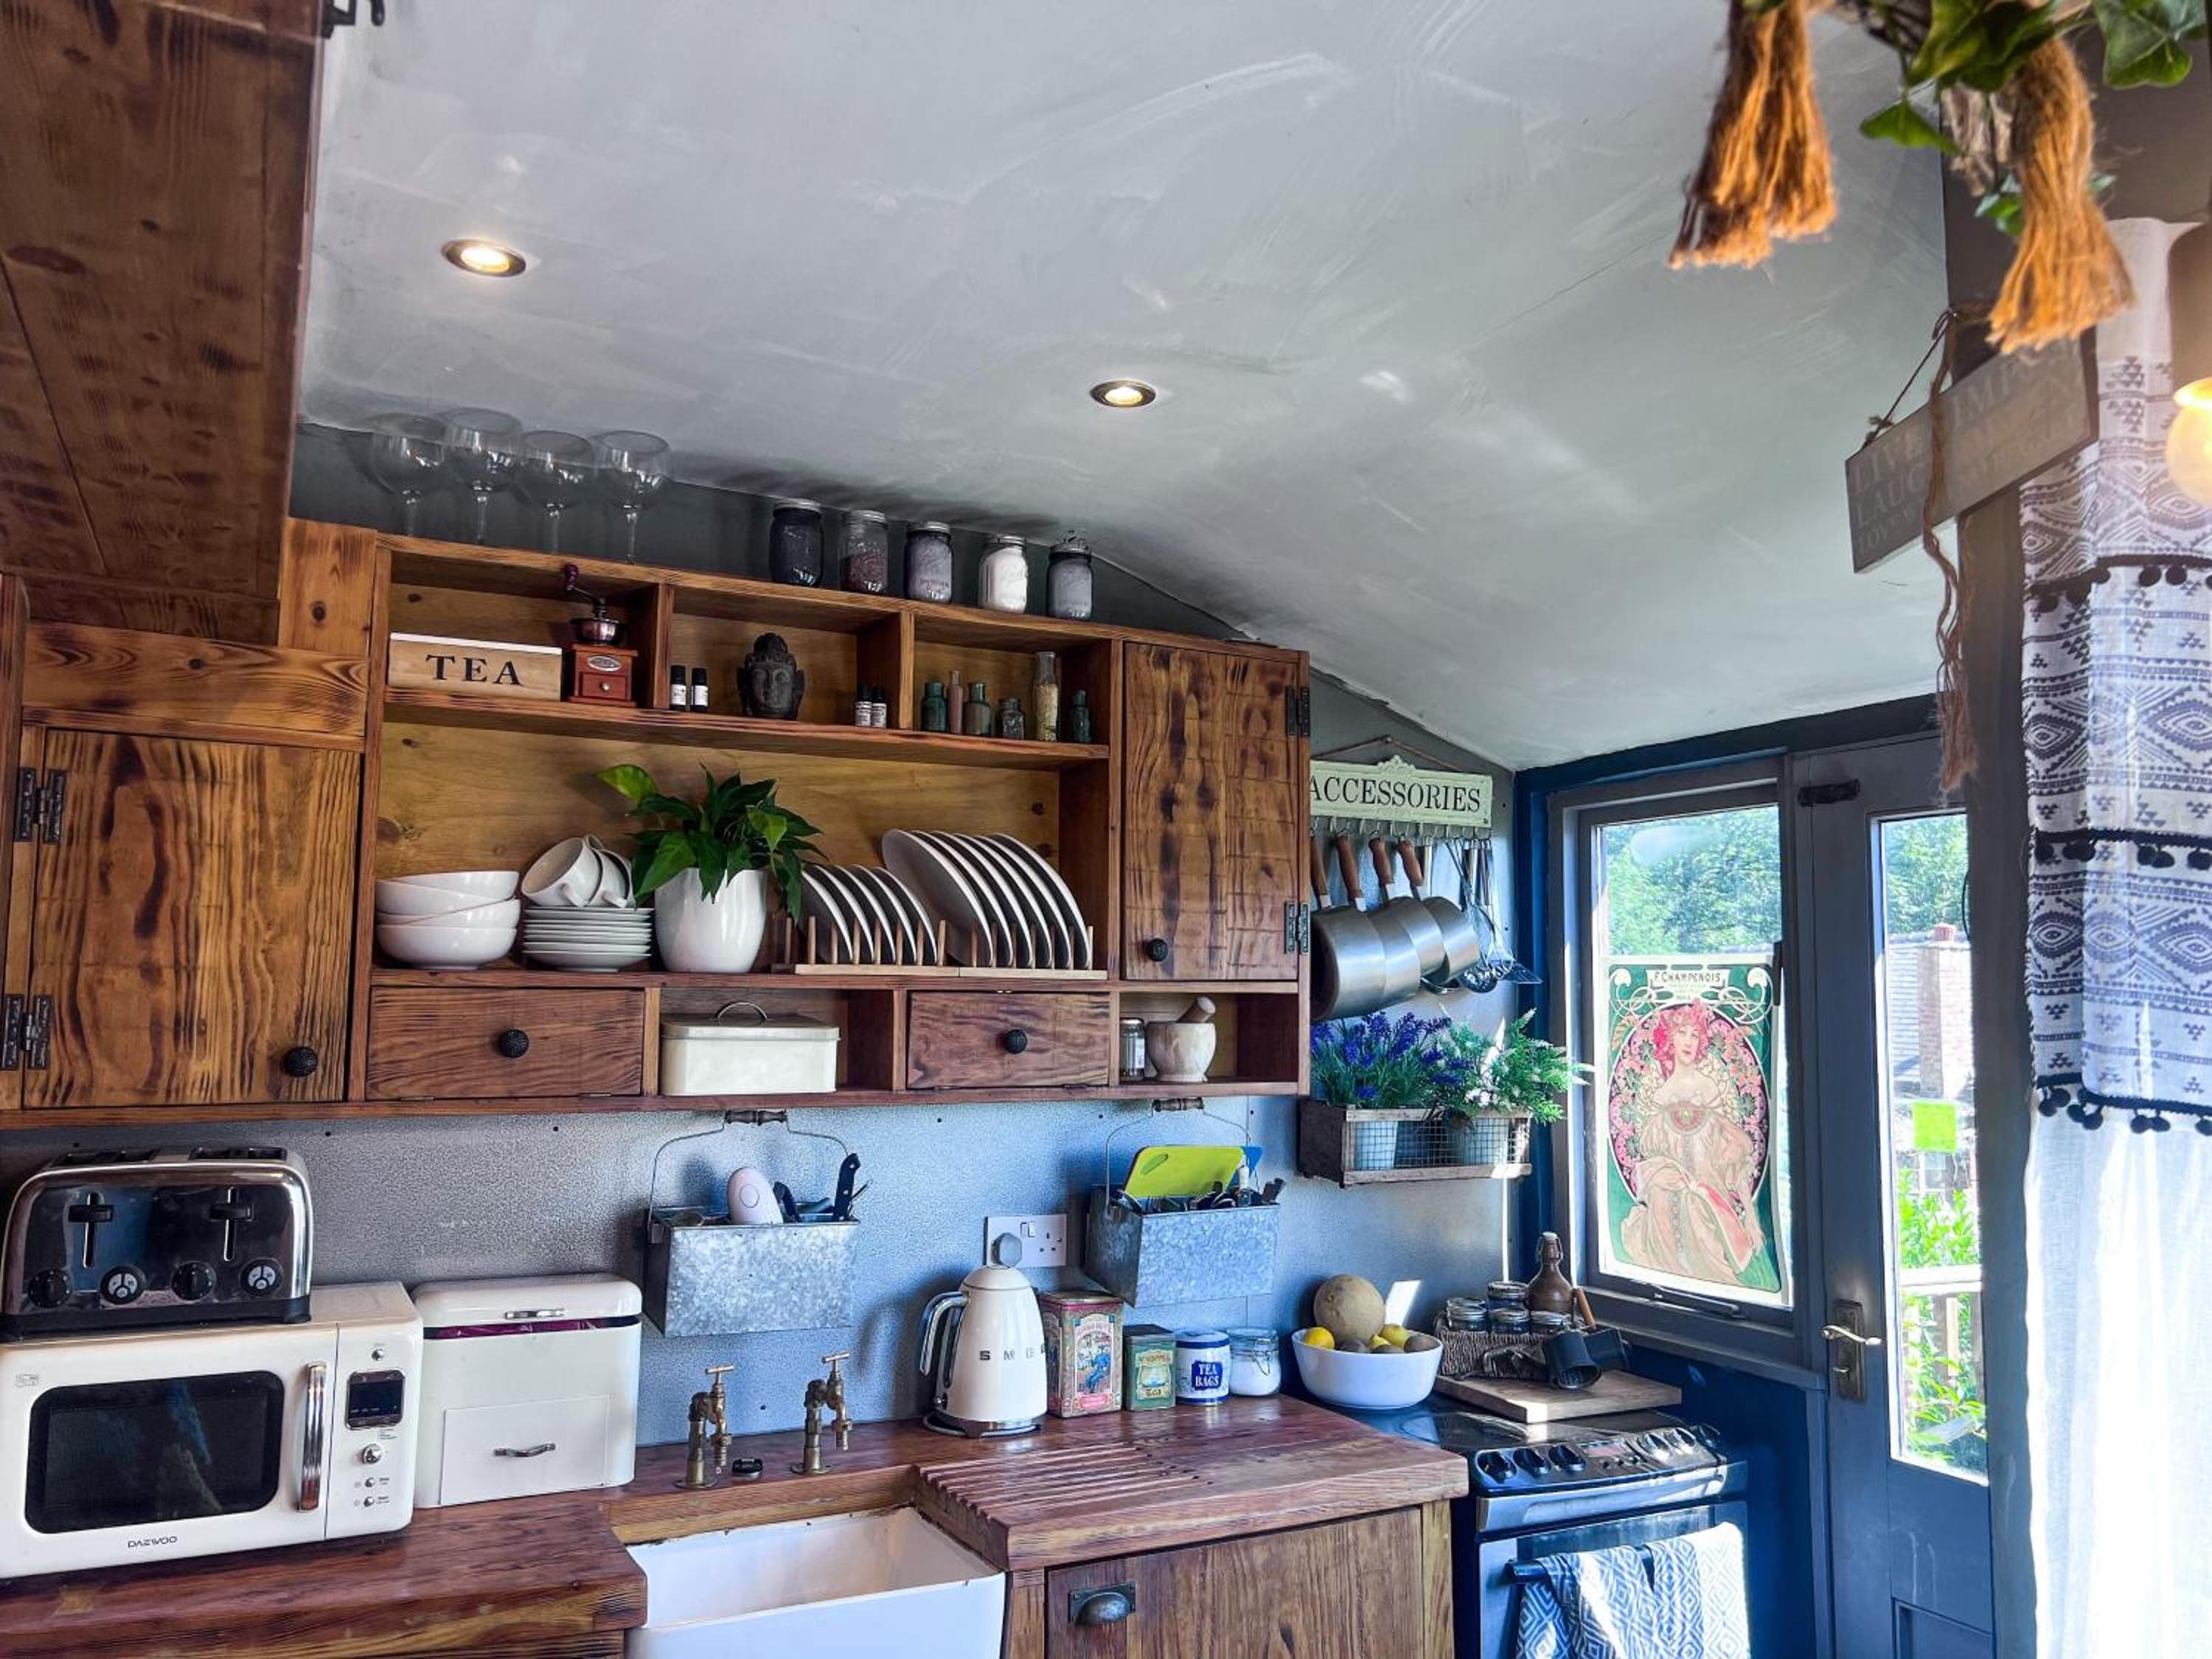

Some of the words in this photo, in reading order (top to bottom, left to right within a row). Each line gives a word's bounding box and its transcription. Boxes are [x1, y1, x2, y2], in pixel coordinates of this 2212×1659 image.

[1856, 463, 1926, 528] LAUG
[425, 653, 524, 686] TEA
[1310, 775, 1481, 813] ACCESSORIES
[1198, 1363, 1217, 1375] TEA
[1194, 1375, 1220, 1388] BAGS
[128, 1536, 178, 1548] DAEWOO
